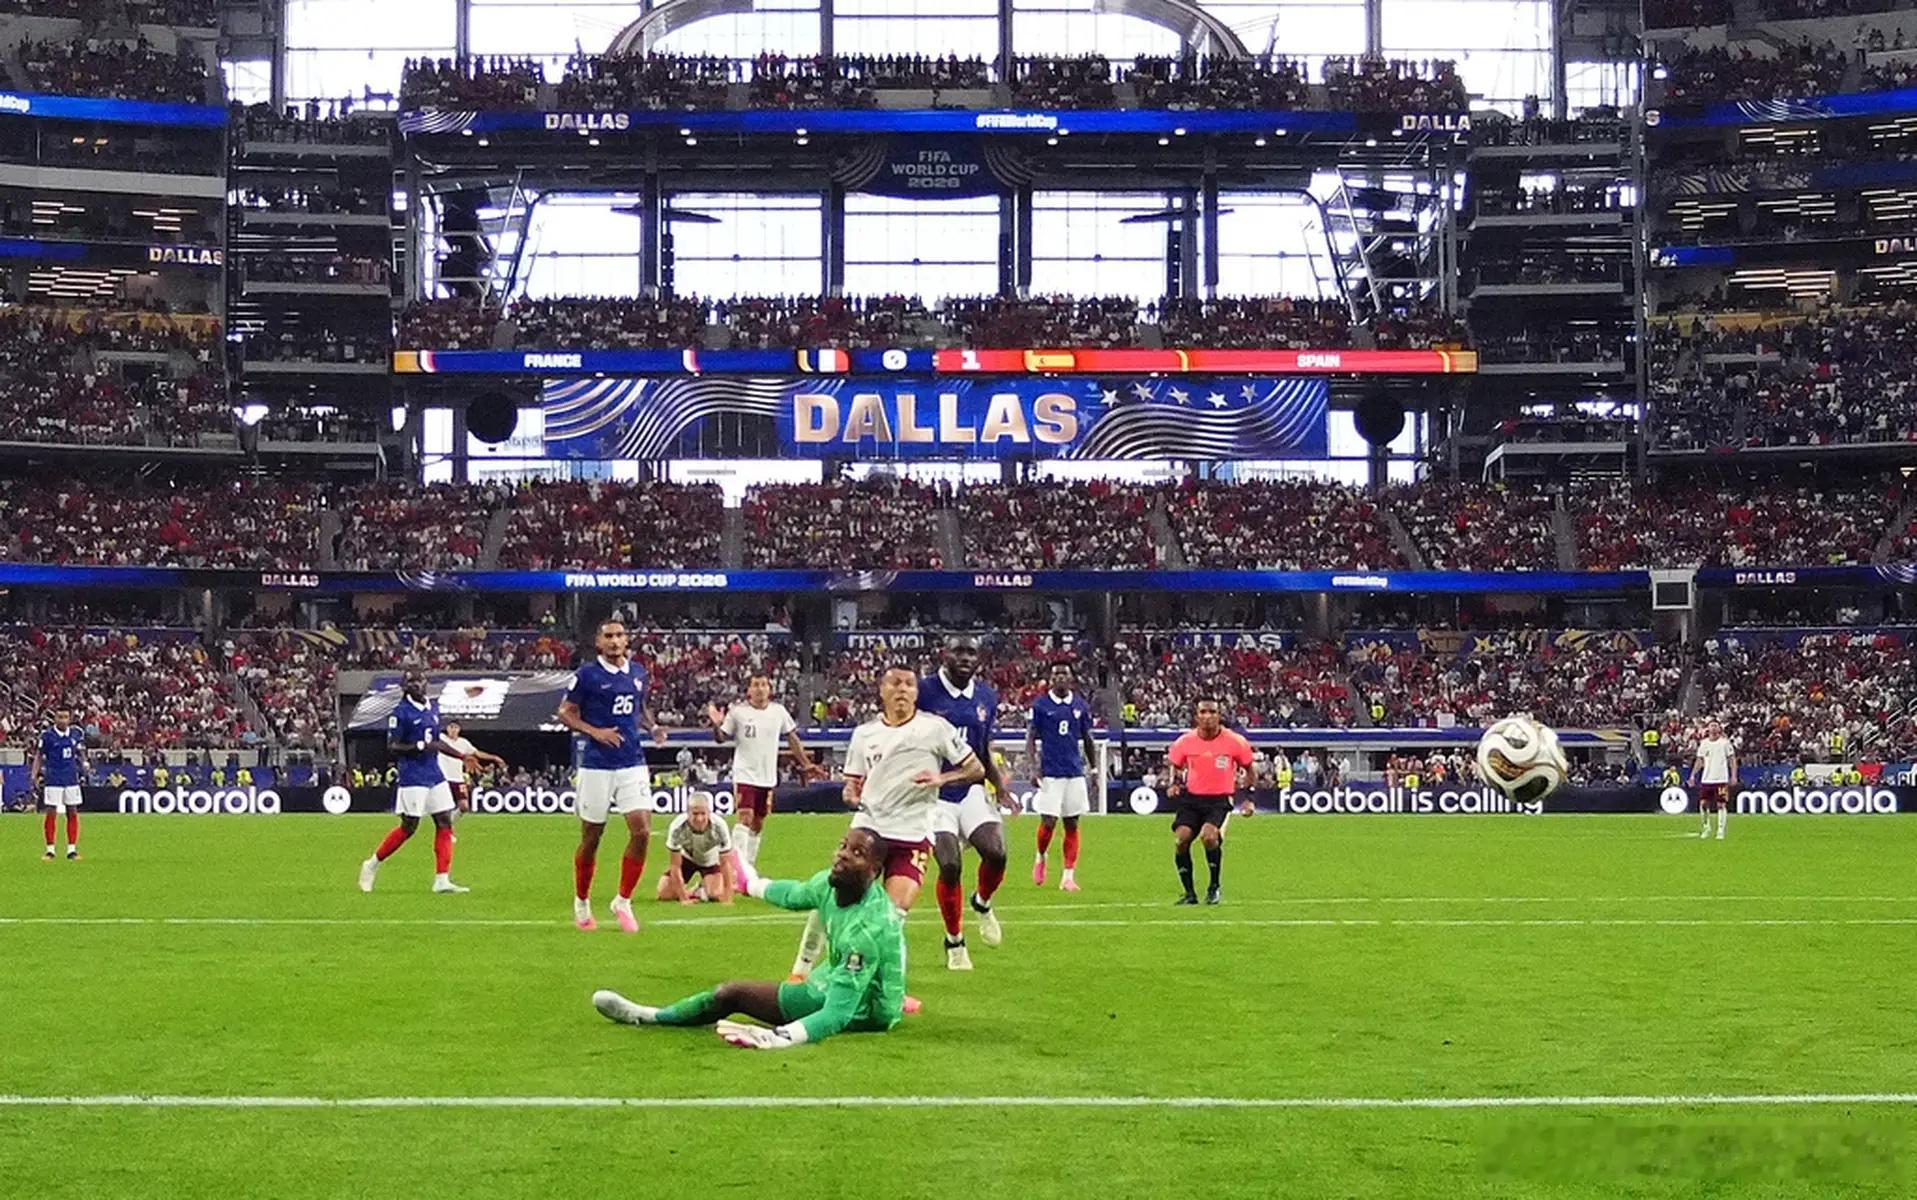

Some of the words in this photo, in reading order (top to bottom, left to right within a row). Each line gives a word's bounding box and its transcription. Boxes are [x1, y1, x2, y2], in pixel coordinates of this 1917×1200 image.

[544, 113, 629, 130] DALLAS
[918, 150, 951, 163] FIFA
[892, 163, 946, 175] WORLD
[949, 163, 980, 175] CUP
[1875, 238, 1917, 254] DAL
[149, 247, 222, 265] DALLAS
[524, 354, 582, 368] FRANCE
[961, 352, 981, 369] 1
[1296, 354, 1341, 368] SPAIN
[793, 393, 1078, 443] DALLAS
[262, 573, 319, 587] DALLAS
[565, 574, 596, 587] FIFA
[597, 574, 648, 587] WORLD
[650, 574, 677, 587] CUP
[974, 574, 1033, 587] DALLAS
[1735, 572, 1796, 585] DALLAS
[612, 695, 634, 716] 26
[424, 727, 433, 744] 6
[744, 724, 757, 739] 21
[1058, 719, 1068, 736] 8
[119, 786, 281, 814] motorola
[471, 785, 577, 814] footba
[1279, 787, 1403, 813] football
[1411, 787, 1433, 813] is
[1736, 786, 1897, 814] motorola
